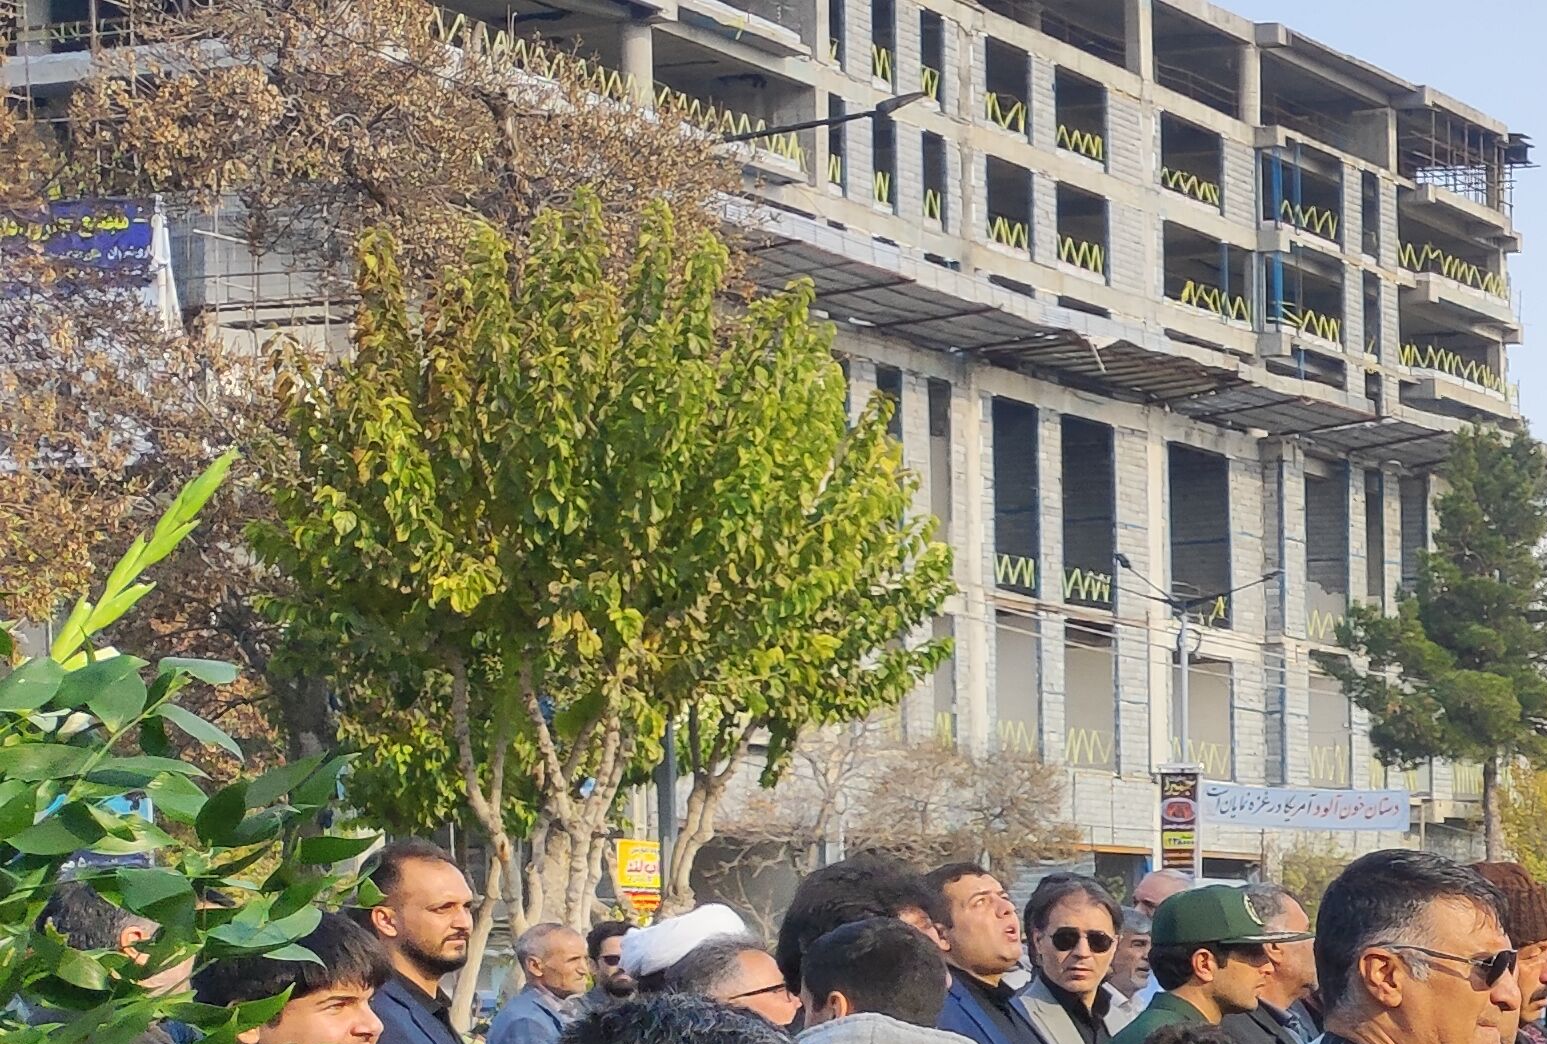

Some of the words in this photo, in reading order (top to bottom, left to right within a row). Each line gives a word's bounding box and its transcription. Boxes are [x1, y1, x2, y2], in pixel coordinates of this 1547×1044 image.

[1206, 787, 1229, 810] است
[1220, 792, 1251, 818] نمایان
[1247, 790, 1271, 815] غزه
[1267, 803, 1281, 814] در
[1284, 793, 1318, 821] آمریکا
[1313, 794, 1343, 817] آلود
[1339, 796, 1364, 819] خون
[1365, 797, 1399, 819] دستان
